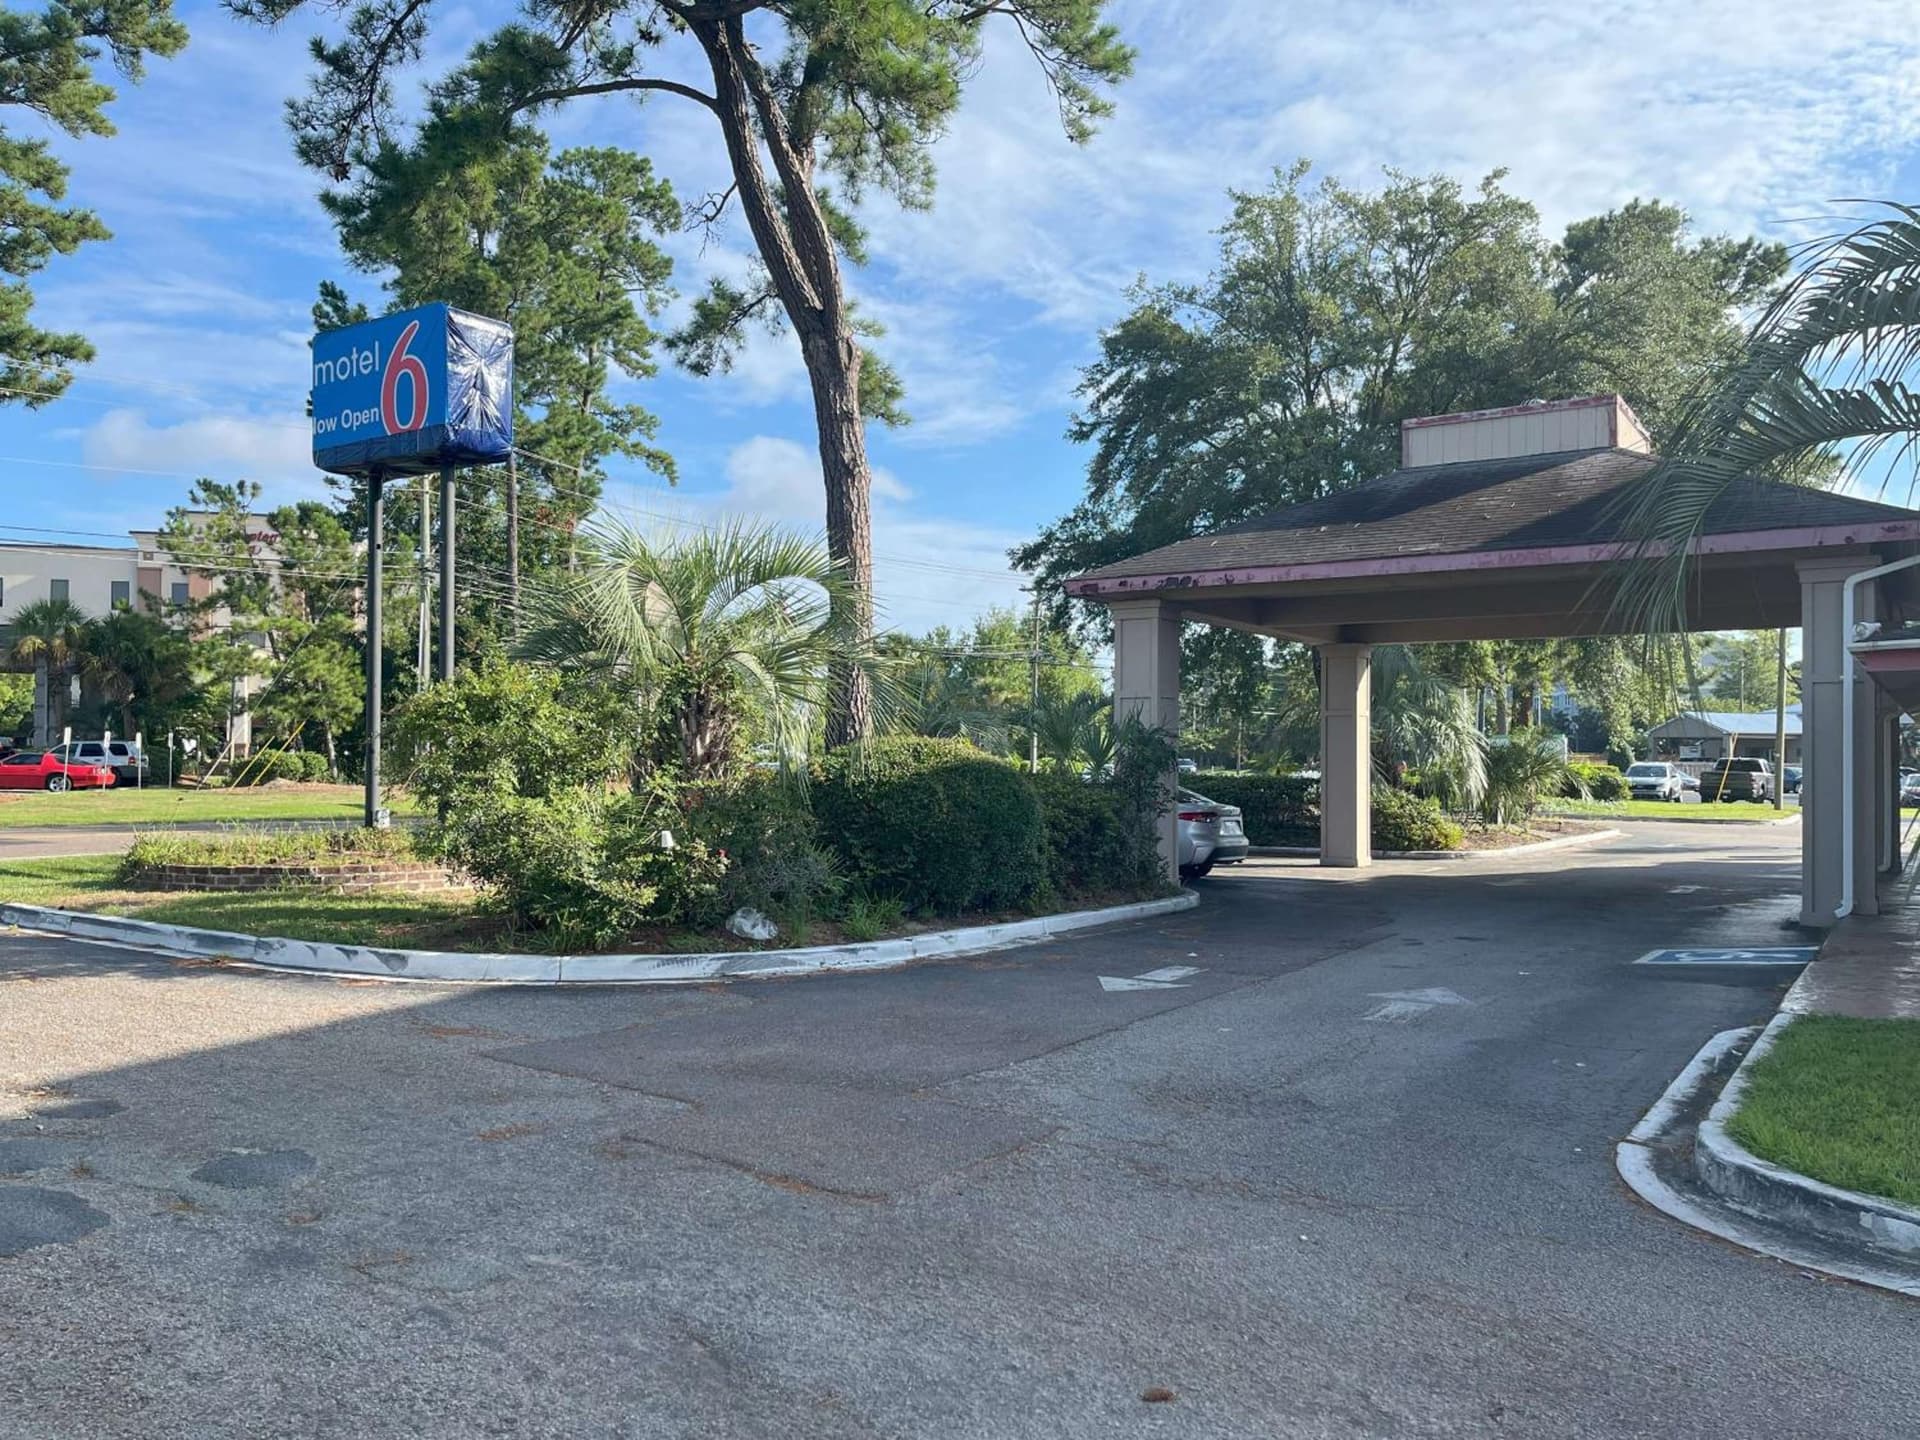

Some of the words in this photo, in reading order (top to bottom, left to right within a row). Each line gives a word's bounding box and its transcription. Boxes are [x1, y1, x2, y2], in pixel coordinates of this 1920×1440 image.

[315, 341, 379, 386] motel
[381, 320, 429, 435] 6
[341, 407, 379, 430] Open
